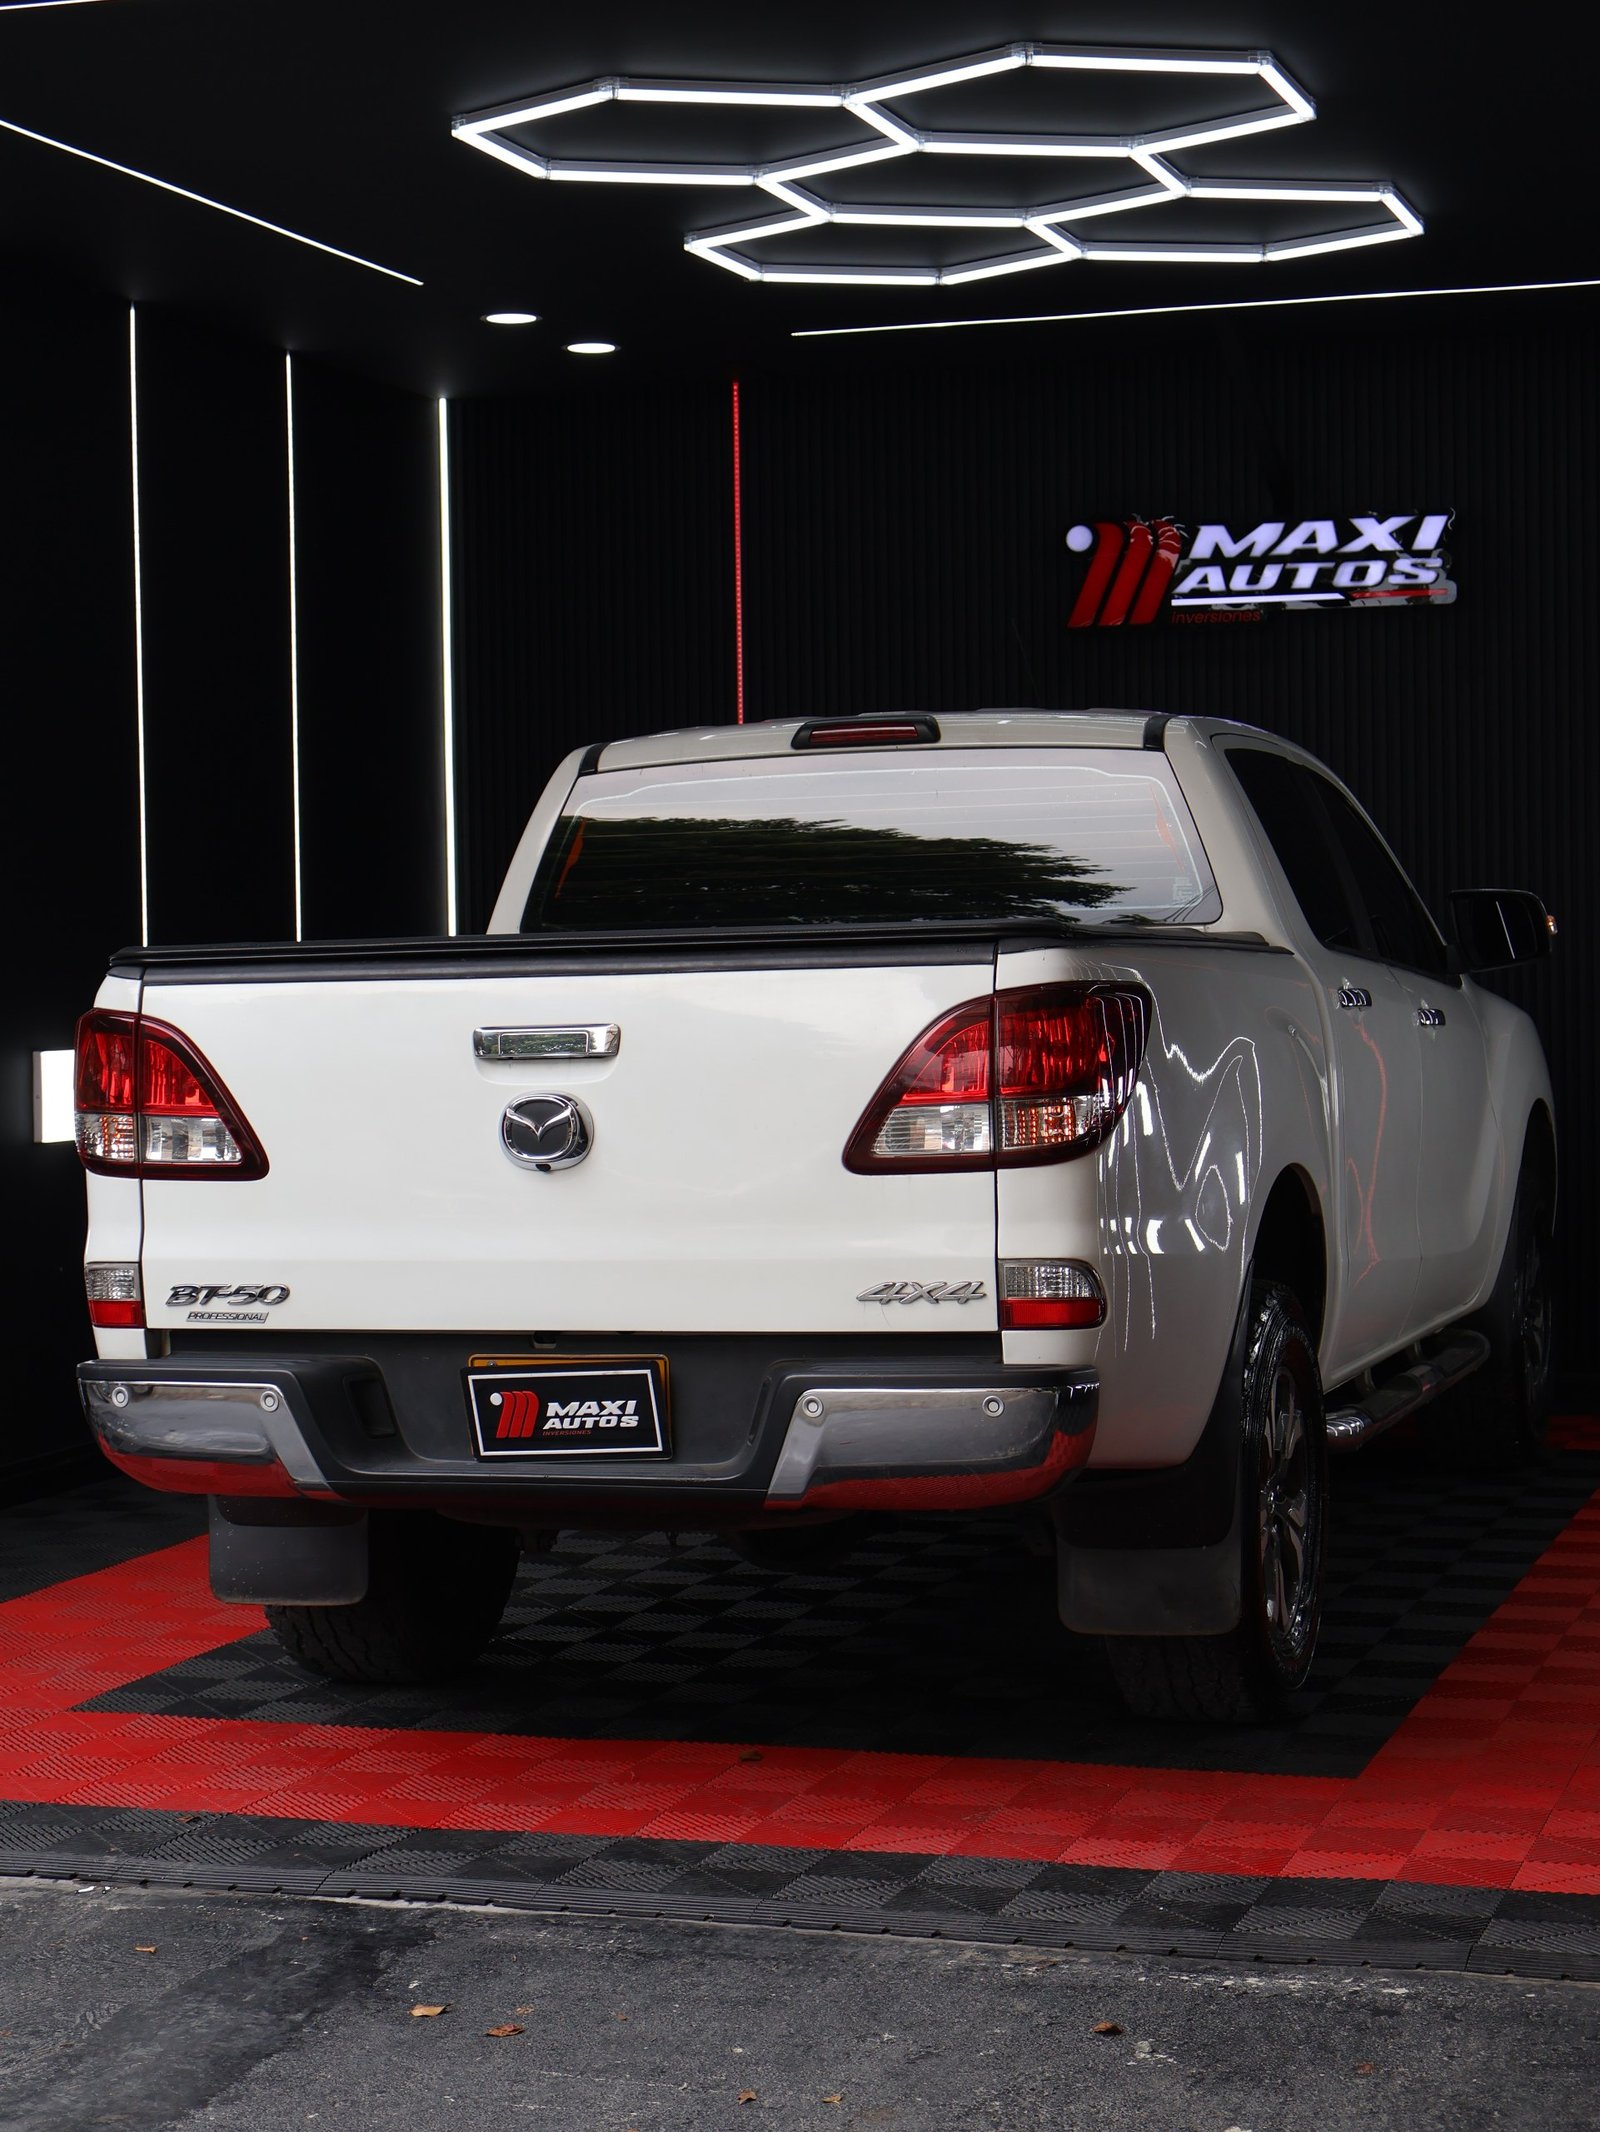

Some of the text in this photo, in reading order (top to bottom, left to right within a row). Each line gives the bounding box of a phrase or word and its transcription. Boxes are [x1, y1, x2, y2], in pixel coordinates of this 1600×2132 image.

[1188, 514, 1449, 559] MAXI
[1172, 557, 1443, 594] AUTOS
[1171, 609, 1262, 625] inversiones
[165, 1284, 291, 1306] BT-50
[187, 1311, 267, 1321] PROFESSIONAL
[545, 1400, 638, 1417] MAXI
[542, 1416, 640, 1430] AUTOS
